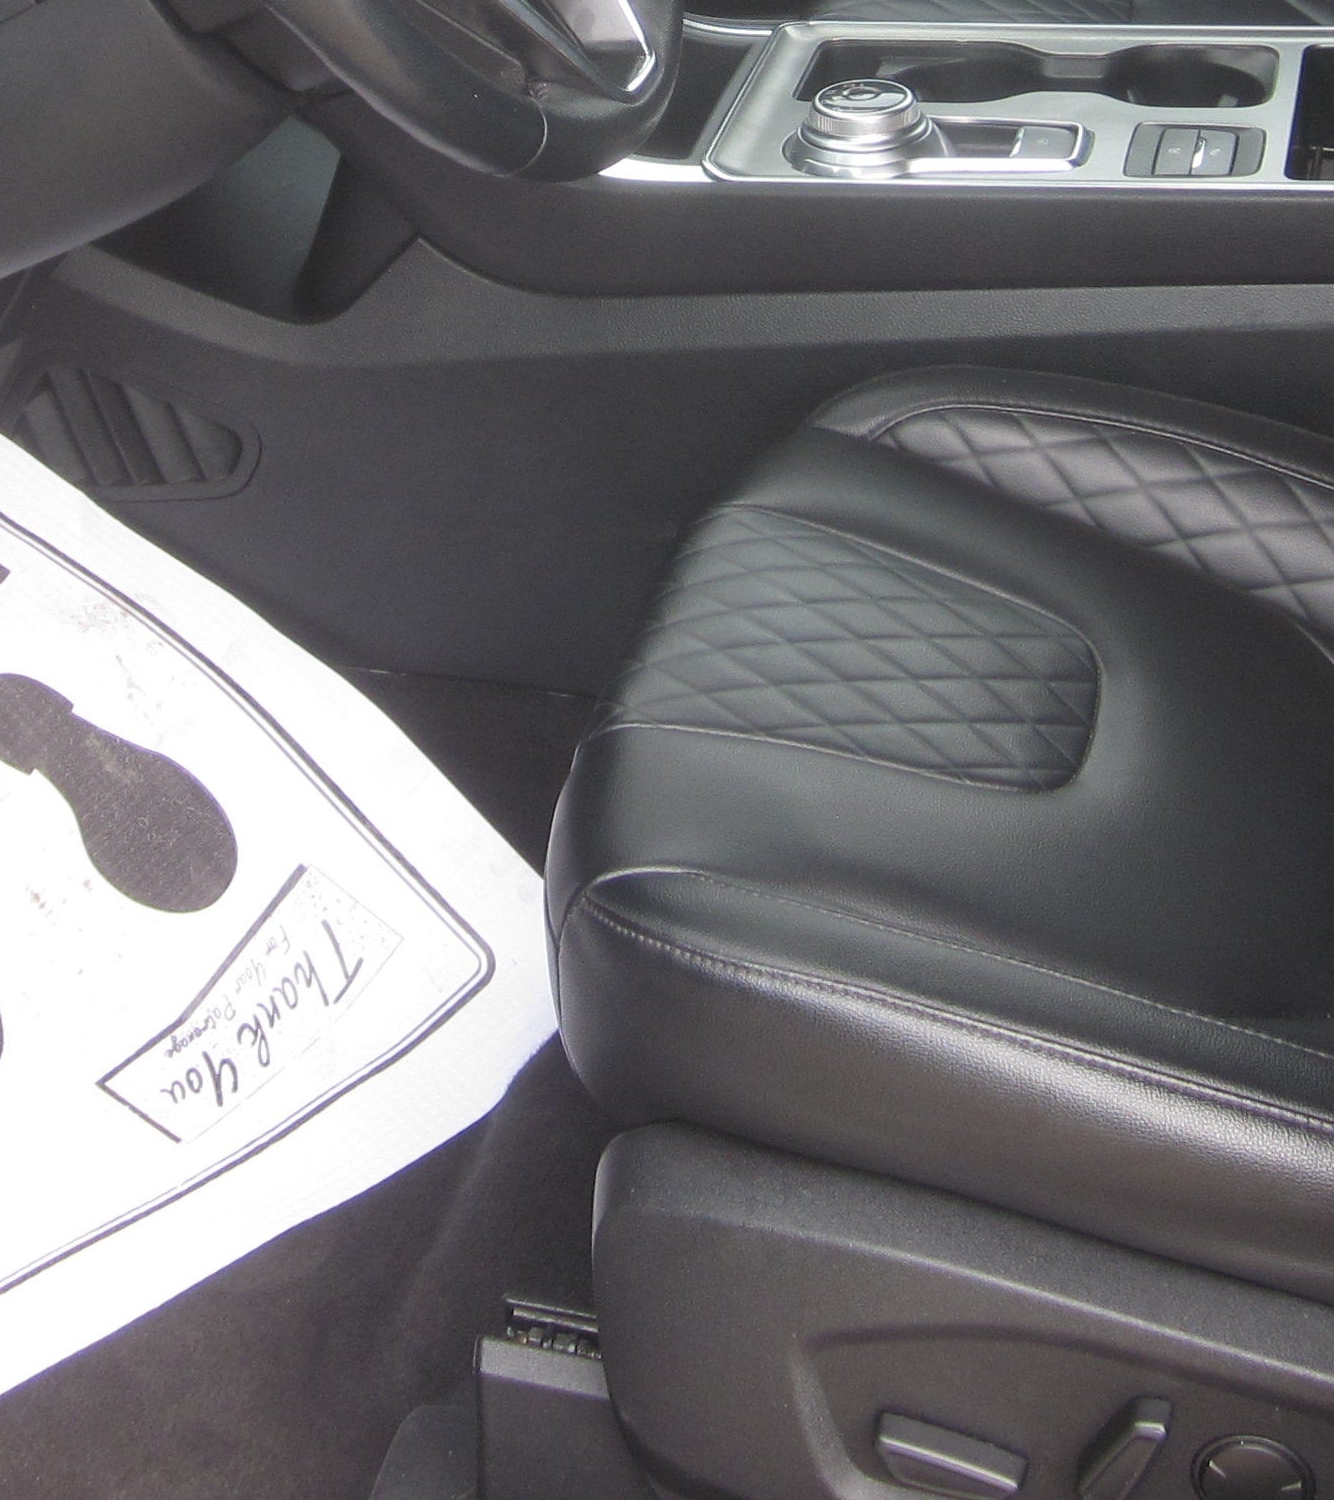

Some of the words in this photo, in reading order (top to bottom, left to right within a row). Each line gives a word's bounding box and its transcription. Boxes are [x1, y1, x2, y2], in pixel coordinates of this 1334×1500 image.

[265, 924, 291, 957] For
[236, 919, 364, 1068] Thank
[160, 1051, 239, 1107] You
